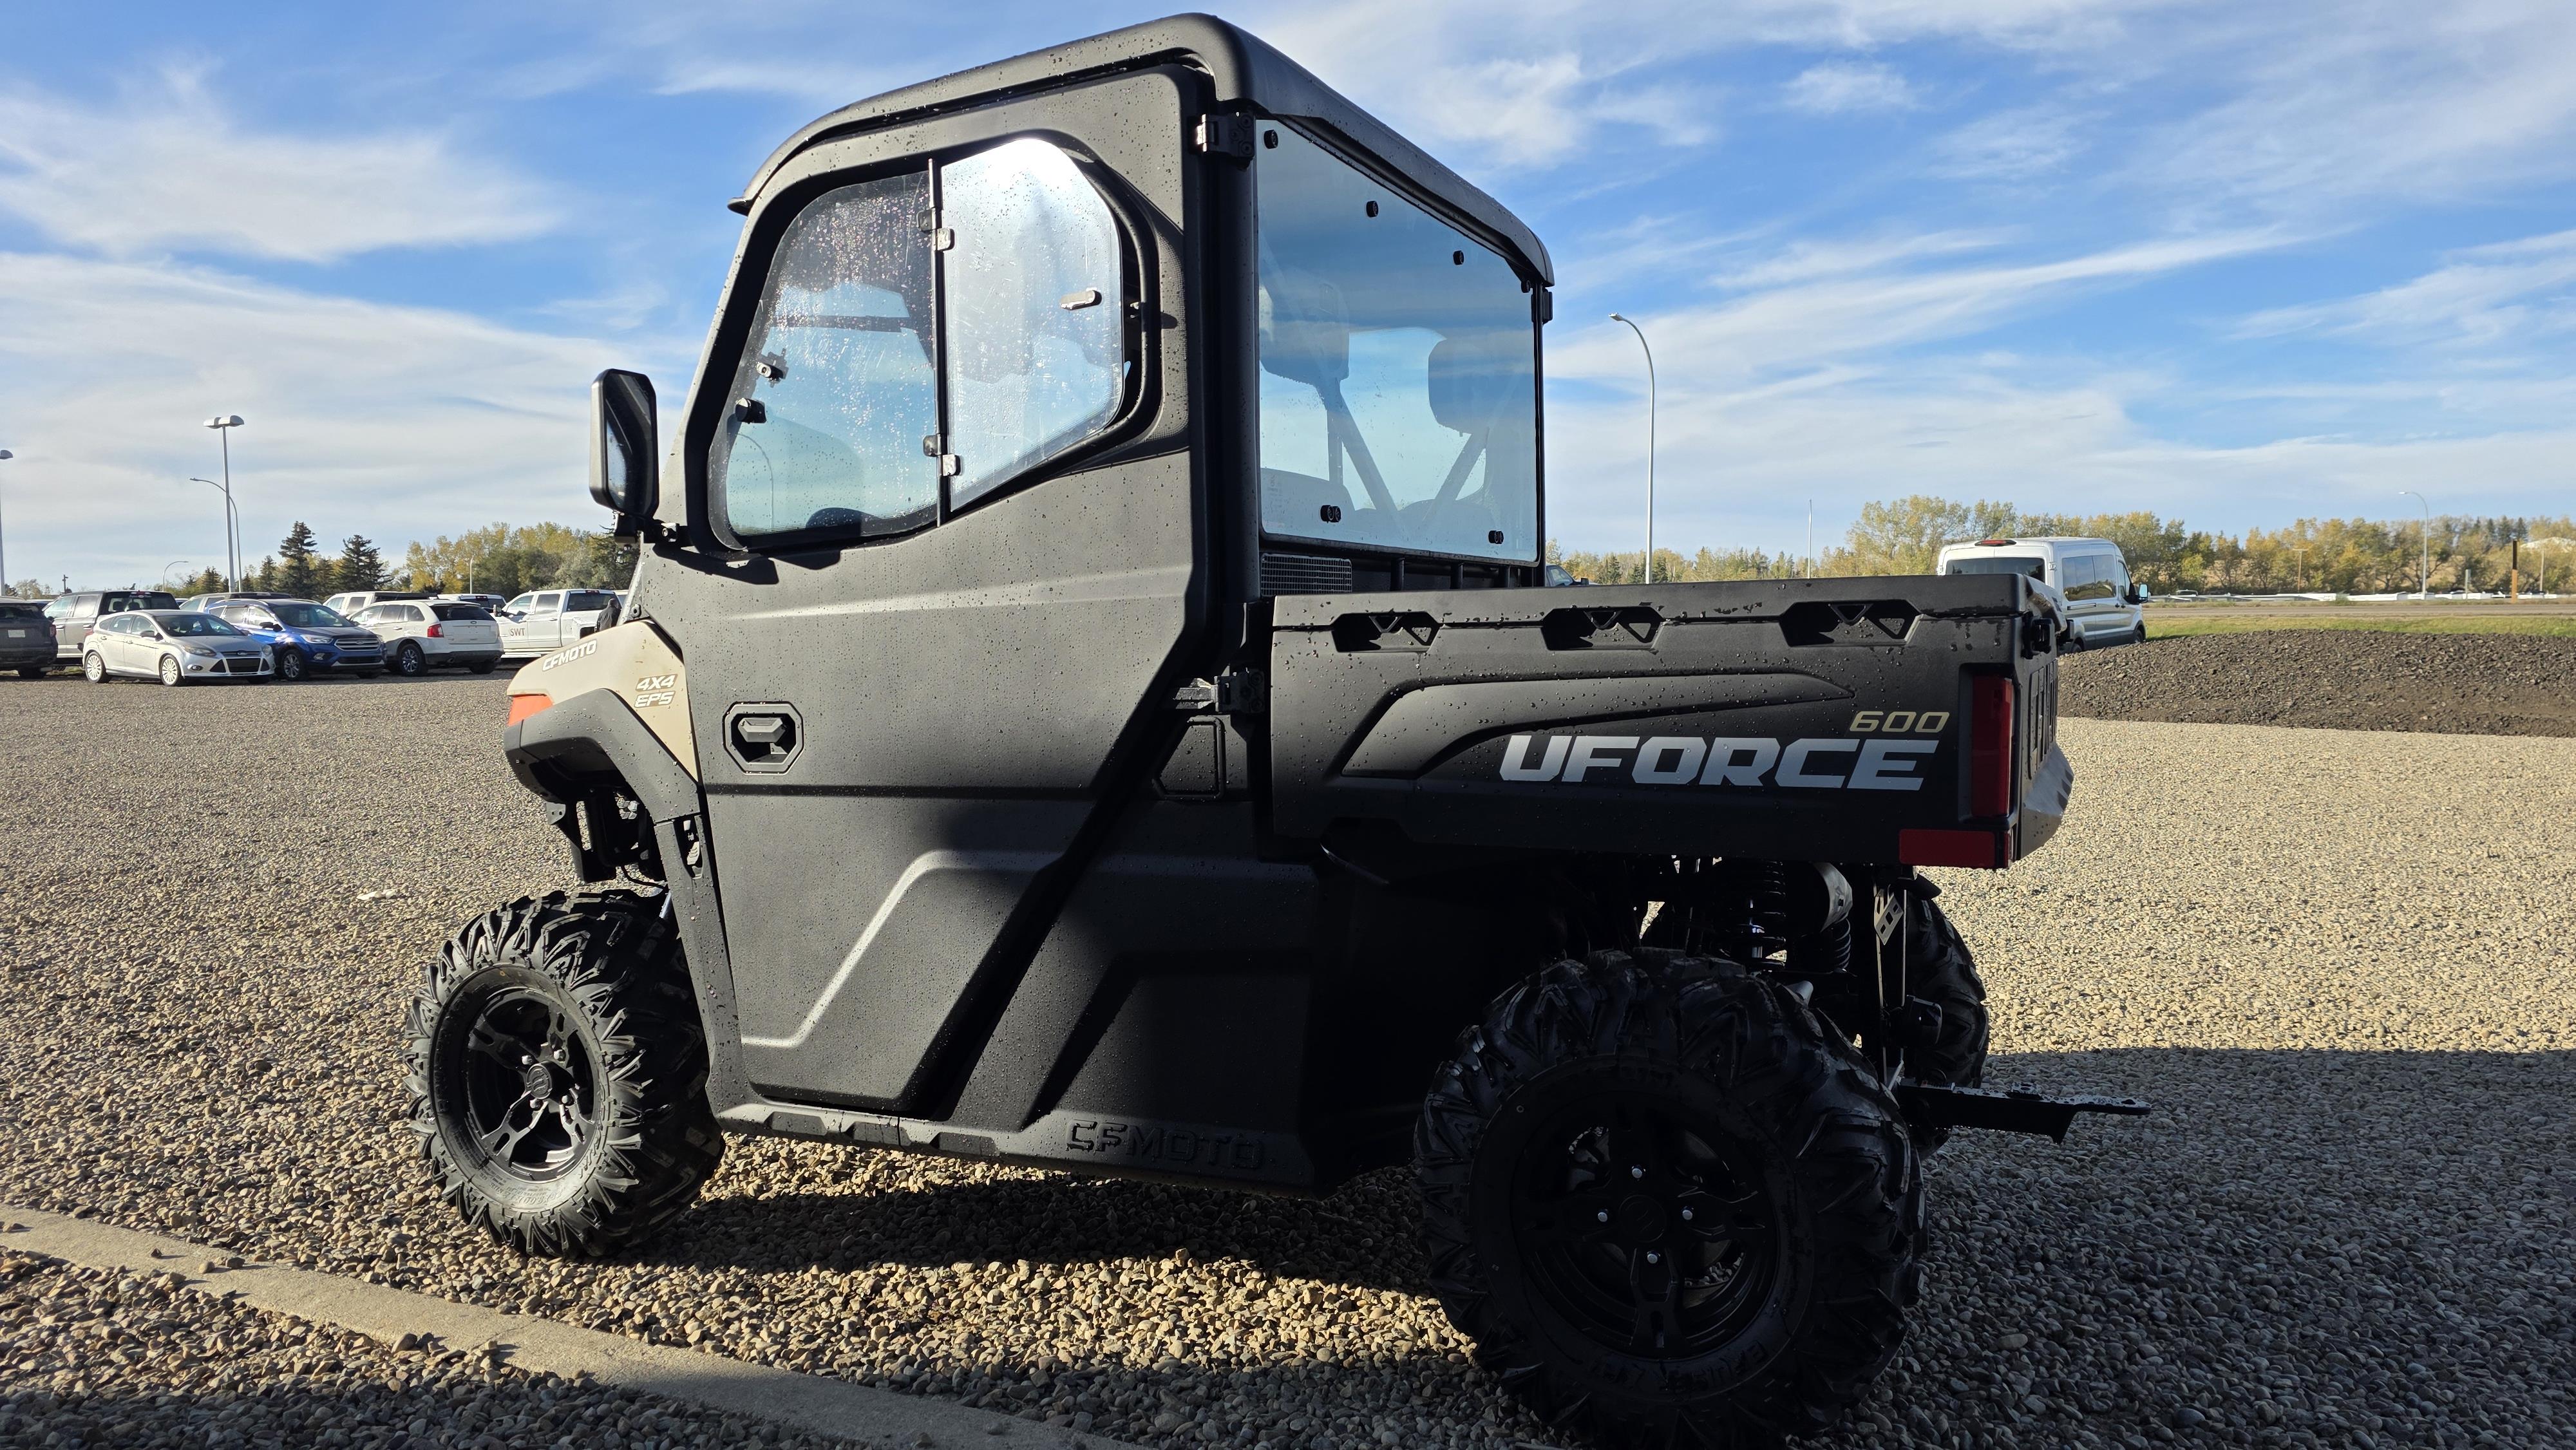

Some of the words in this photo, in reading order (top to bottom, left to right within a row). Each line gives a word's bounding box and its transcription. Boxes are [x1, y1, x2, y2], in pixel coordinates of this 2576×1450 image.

[542, 640, 597, 671] CFMOTO
[636, 675, 676, 690] 4X4
[634, 691, 675, 707] EPS
[1850, 711, 1950, 733] 600
[1499, 735, 1939, 791] UFORCE
[1067, 1118, 1263, 1169] CFMOTO
